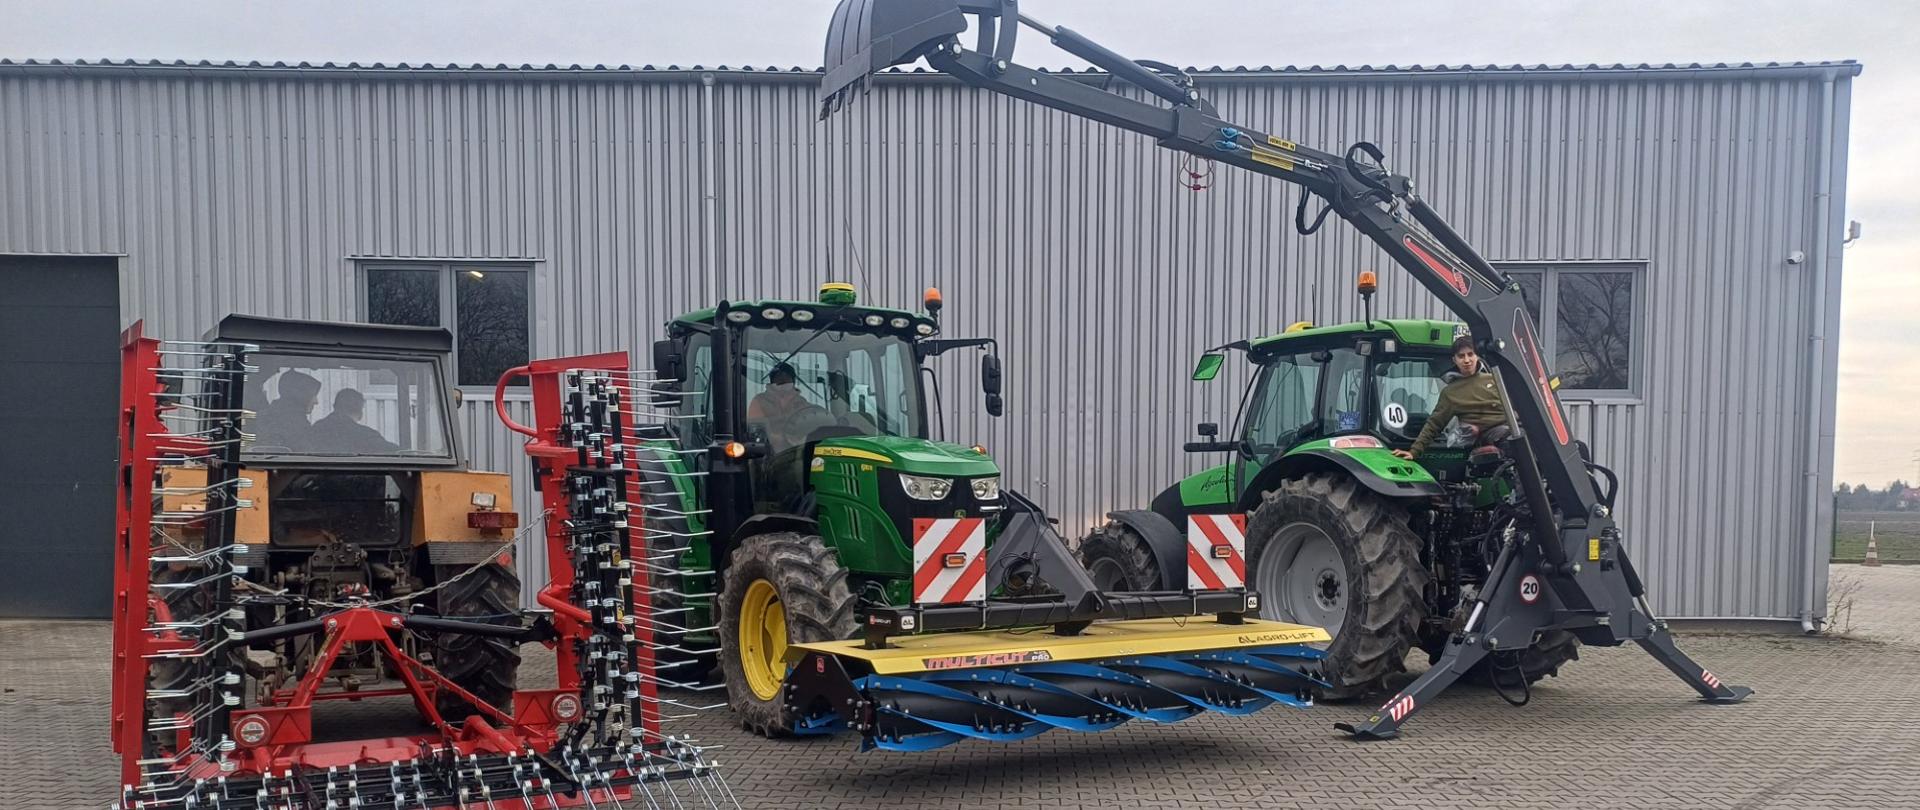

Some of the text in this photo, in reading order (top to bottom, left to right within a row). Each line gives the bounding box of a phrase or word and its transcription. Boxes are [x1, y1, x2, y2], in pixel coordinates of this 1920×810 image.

[1389, 407, 1403, 423] 40
[1523, 582, 1538, 595] 20
[1256, 632, 1315, 641] AGRO-LIFT
[927, 652, 1029, 669] MULTICUT
